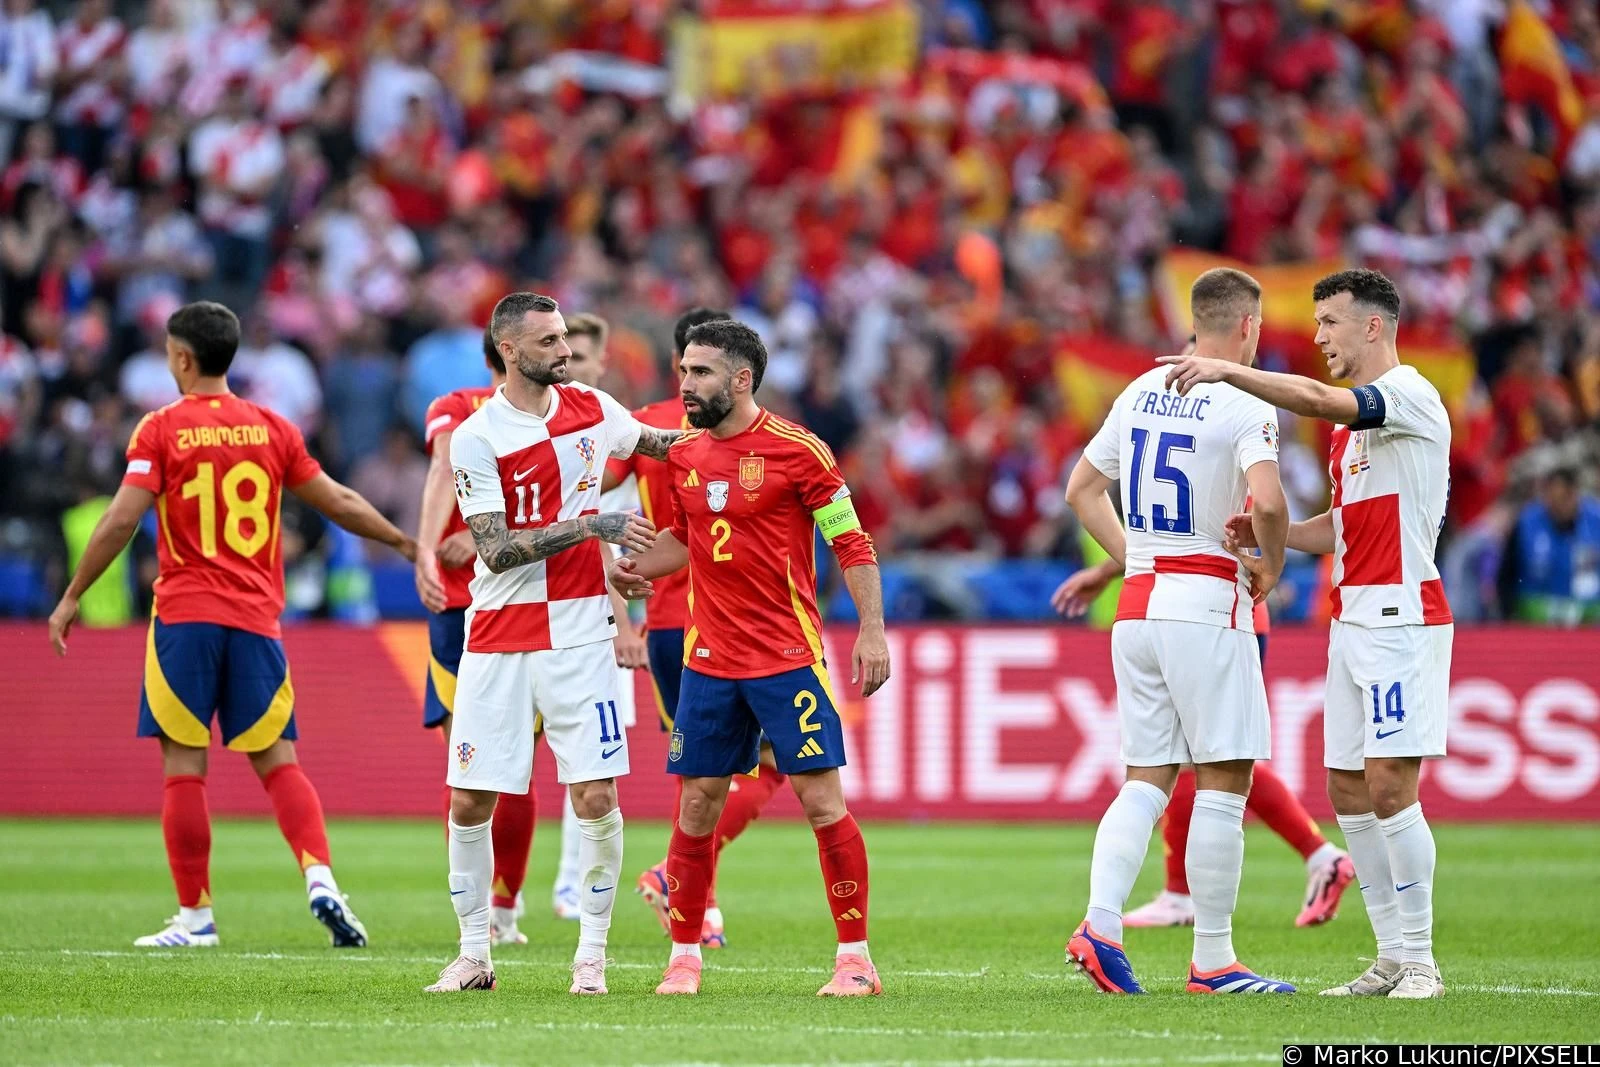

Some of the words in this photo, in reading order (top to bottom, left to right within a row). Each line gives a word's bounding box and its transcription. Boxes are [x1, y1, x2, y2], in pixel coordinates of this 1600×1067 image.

[176, 425, 269, 450] ZUBIMENDI
[514, 482, 542, 525] 11
[1128, 427, 1196, 536] 15
[182, 460, 271, 558] 18
[828, 510, 854, 526] RESPECT
[710, 518, 733, 562] 2
[594, 700, 622, 743] 11
[794, 689, 822, 734] 2
[822, 629, 1600, 803] liExrss
[1370, 681, 1406, 725] 14
